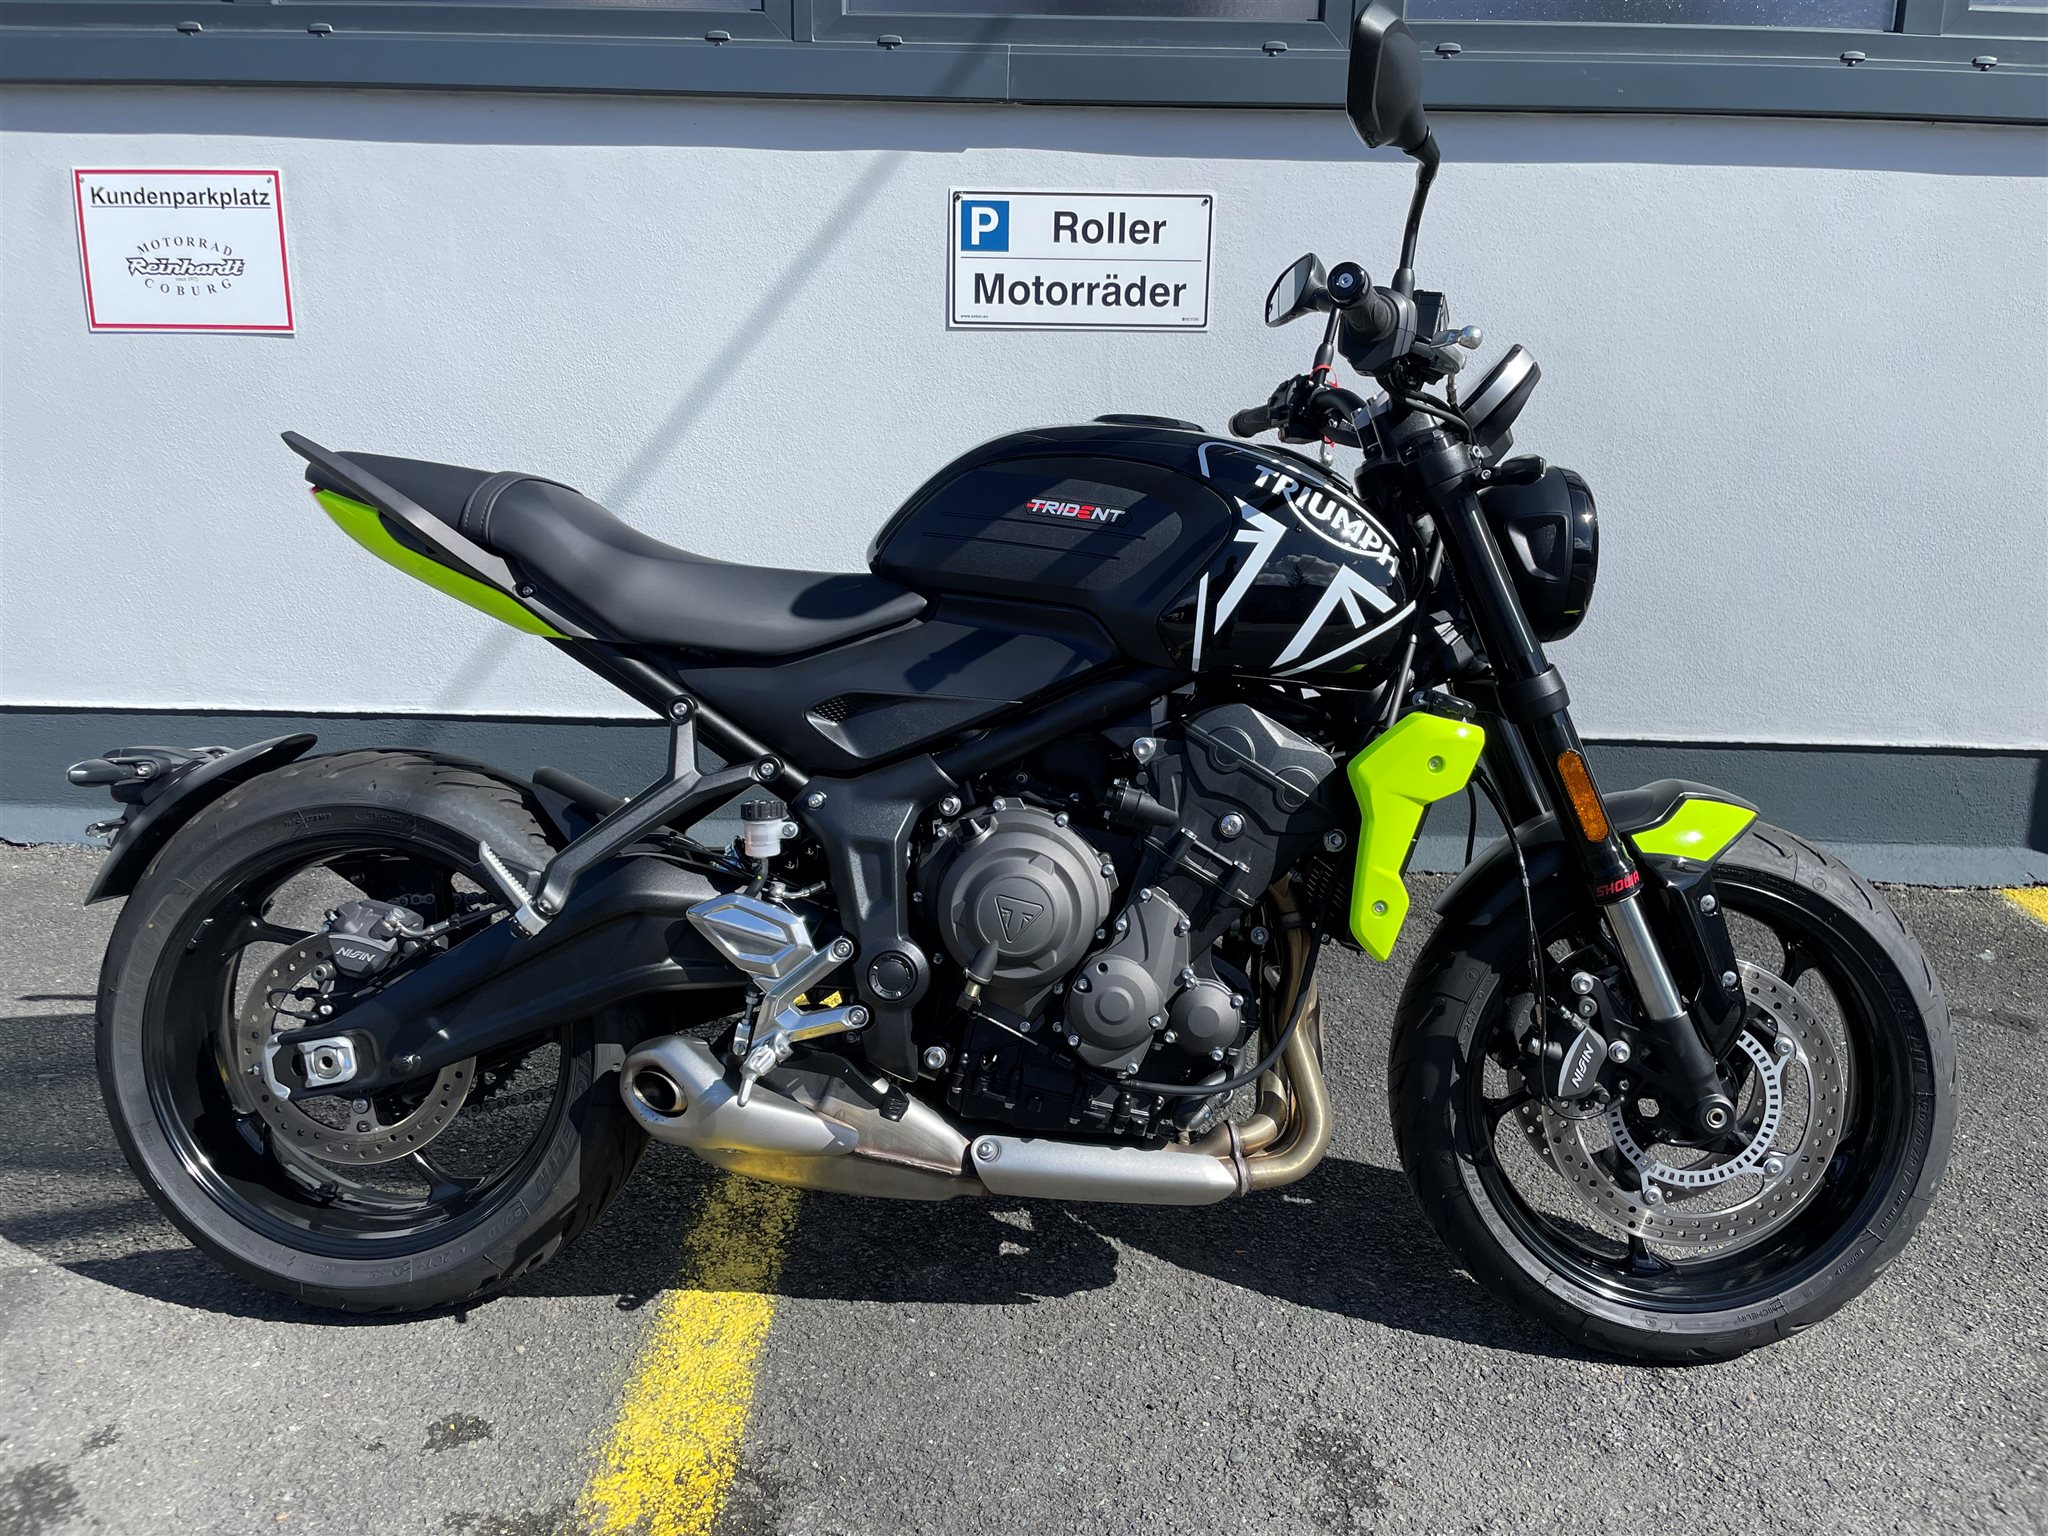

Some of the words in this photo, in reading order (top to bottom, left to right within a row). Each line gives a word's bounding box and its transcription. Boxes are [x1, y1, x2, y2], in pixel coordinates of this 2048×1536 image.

[90, 186, 271, 210] Kundenparkplatz
[971, 206, 999, 246] P
[1053, 211, 1167, 245] Roller
[136, 236, 233, 256] MOTORRAD
[126, 257, 245, 277] Reinhardt
[144, 278, 232, 296] COBURG
[974, 273, 1187, 308] Motorräder
[1026, 497, 1126, 525] TRIDENT
[1255, 464, 1400, 578] TRIUMPH
[1596, 869, 1641, 897] SHOWA
[1737, 1303, 1781, 1322] MICHELIN
